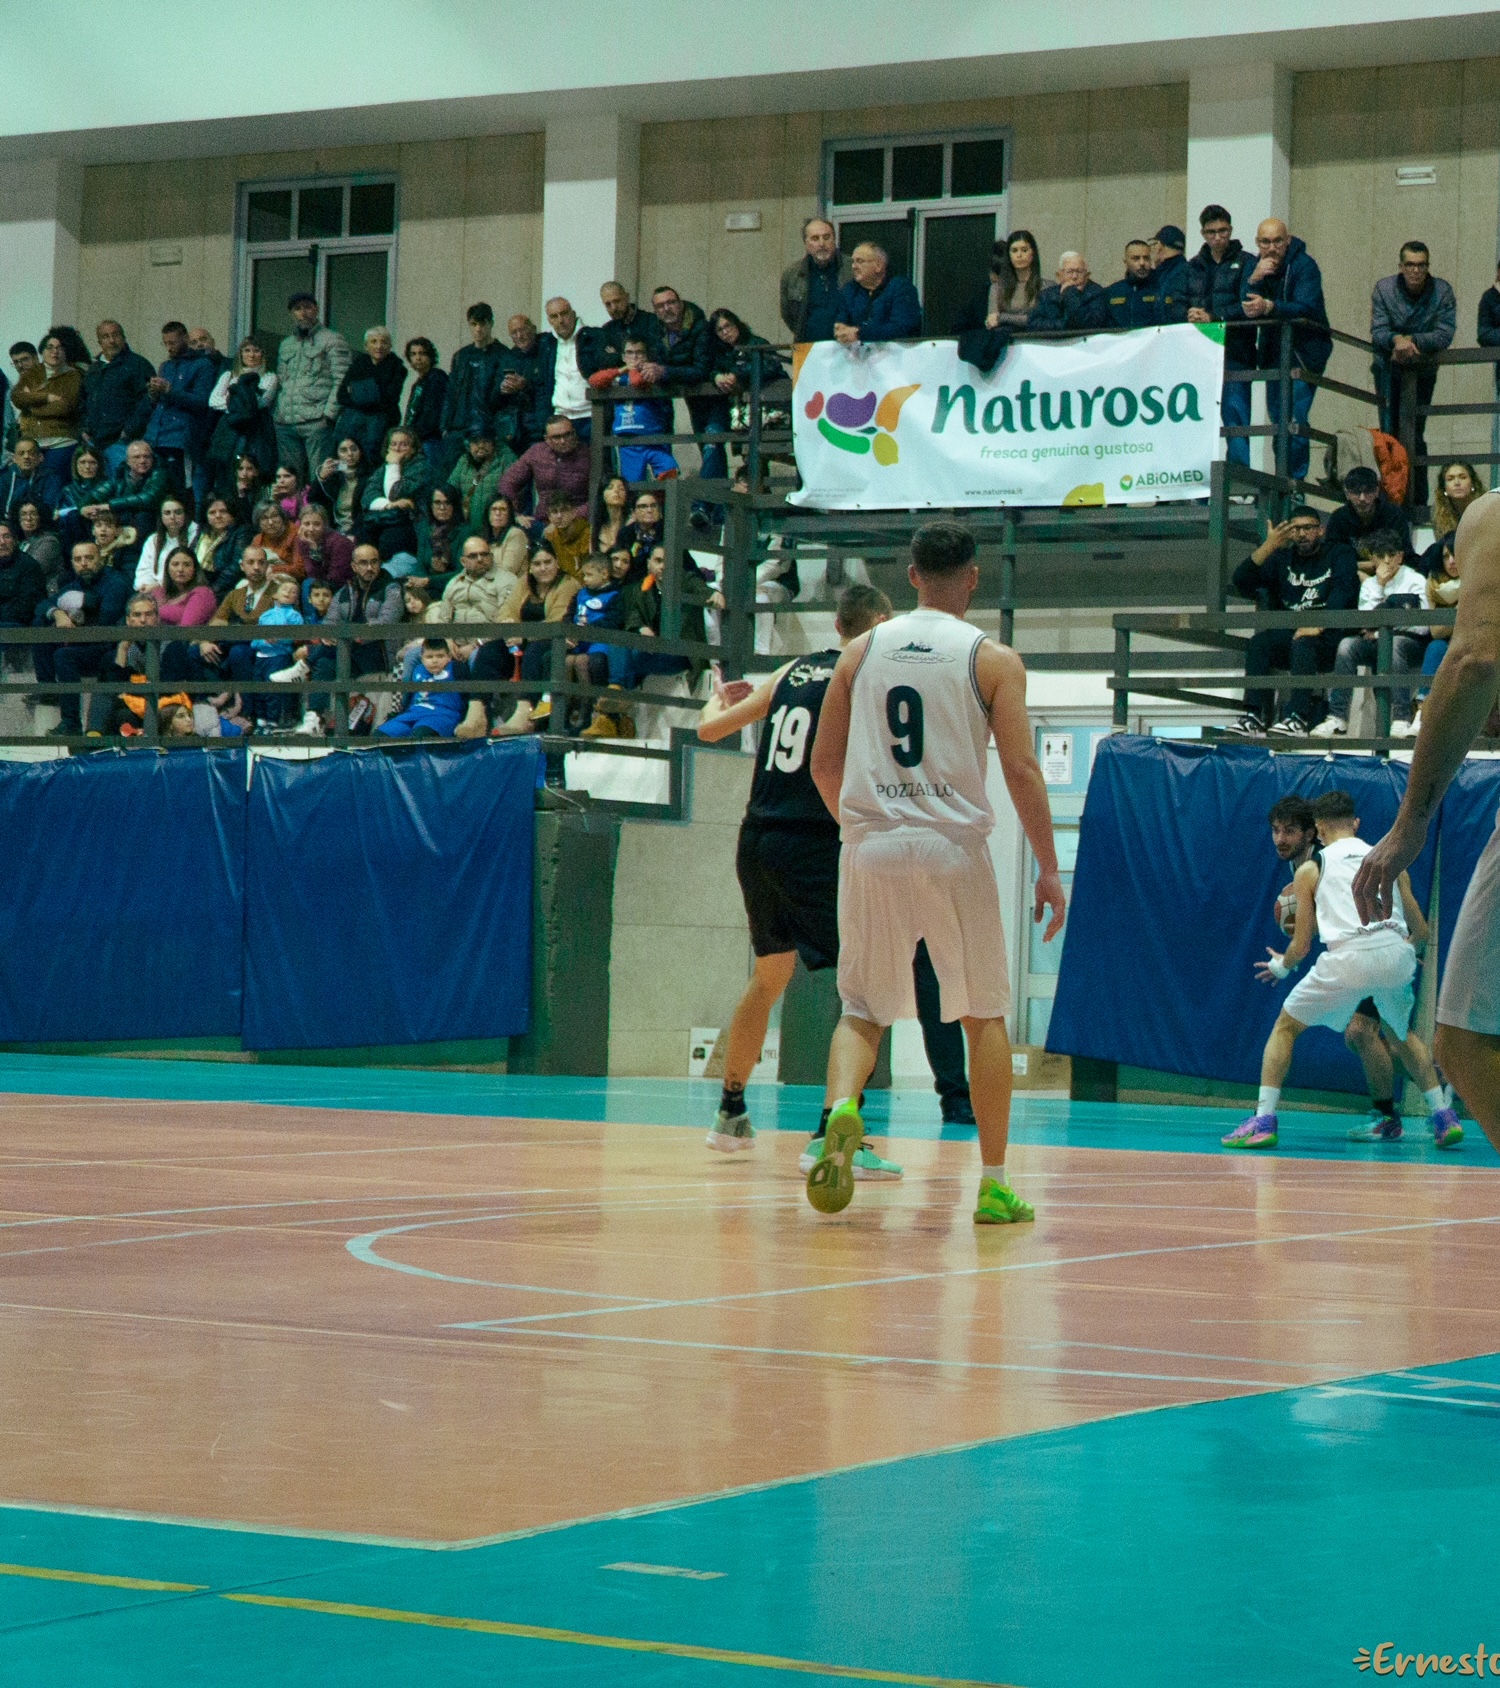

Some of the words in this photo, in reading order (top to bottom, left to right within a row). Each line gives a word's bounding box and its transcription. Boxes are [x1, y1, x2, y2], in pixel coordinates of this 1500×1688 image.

[980, 446, 1028, 459] fresca
[1031, 443, 1090, 462] genuina
[1094, 442, 1154, 460] gustosa
[964, 487, 1024, 497] www.naturosa.it
[886, 685, 924, 768] 9
[765, 704, 812, 774] 19
[876, 782, 954, 799] POZZALLO
